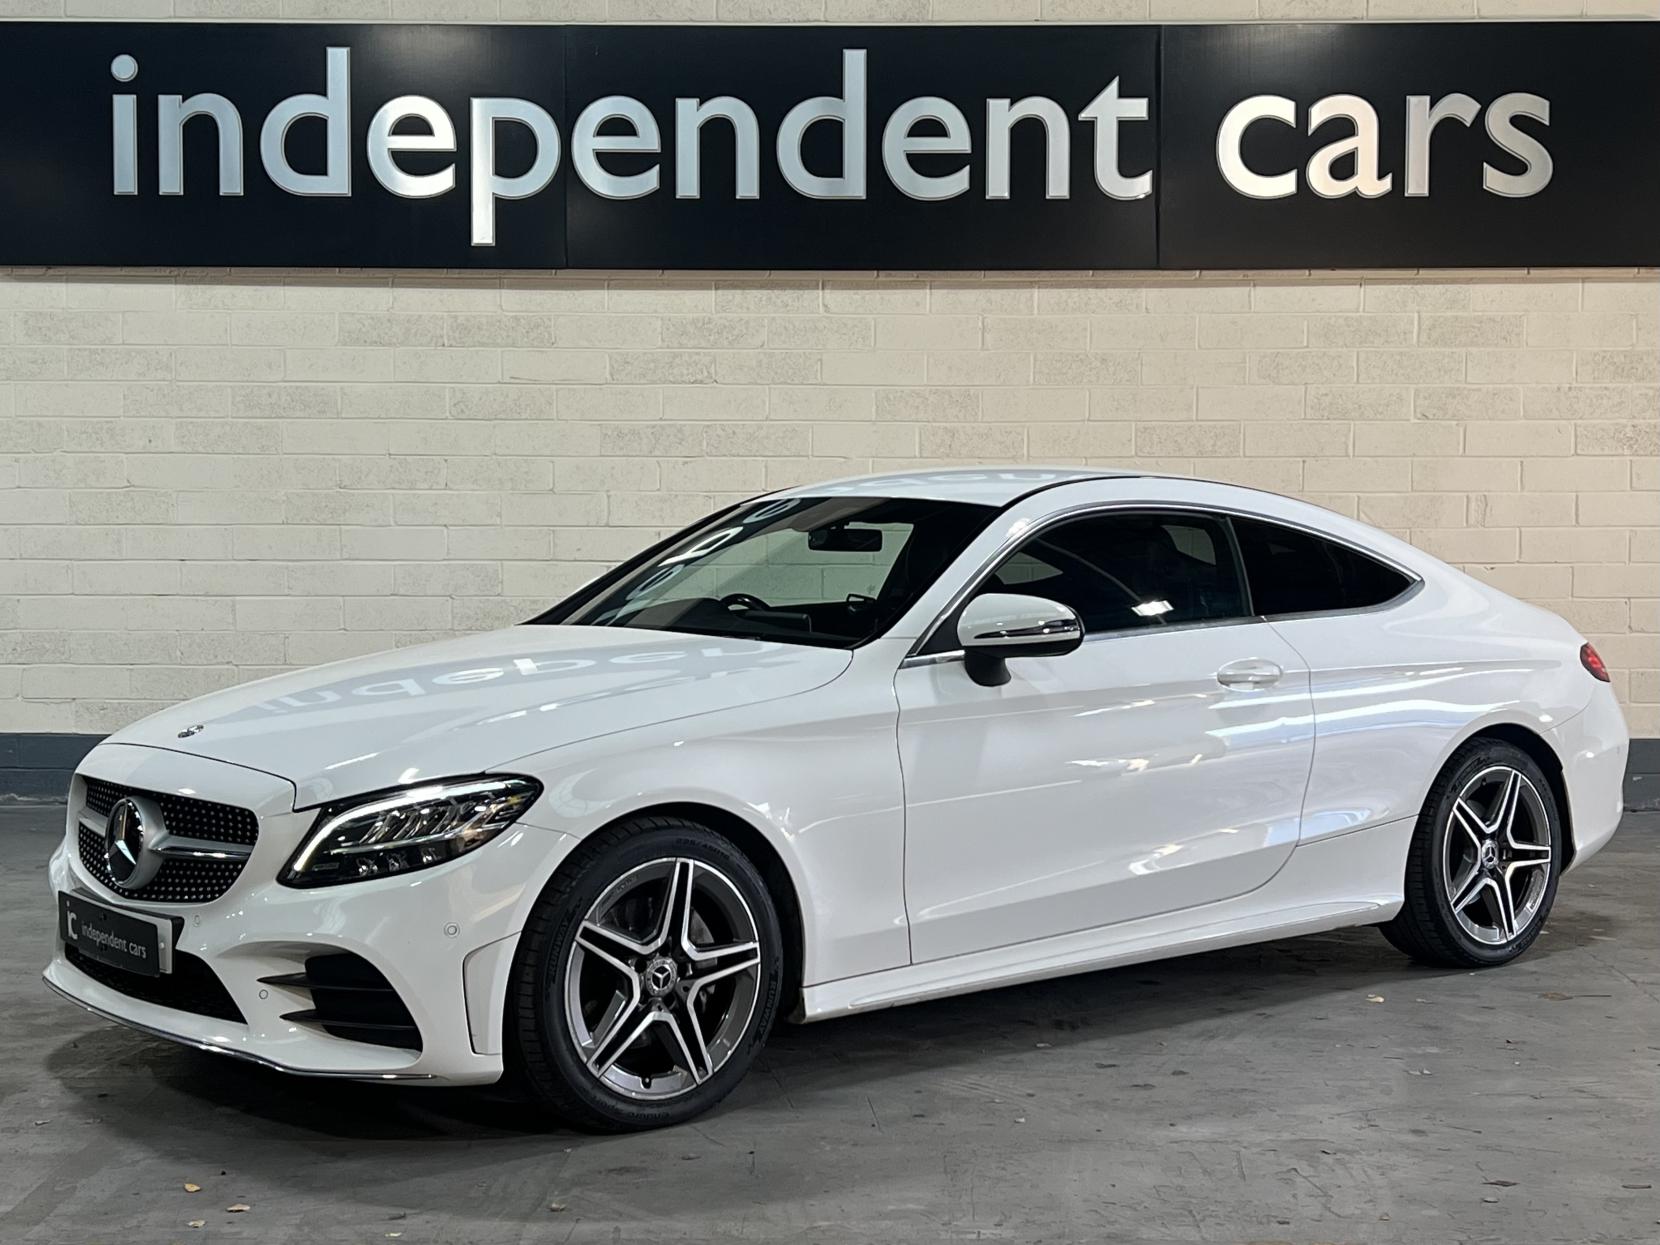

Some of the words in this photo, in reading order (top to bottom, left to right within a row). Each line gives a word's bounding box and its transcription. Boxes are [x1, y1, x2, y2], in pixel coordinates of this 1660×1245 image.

[110, 46, 1153, 247] independent
[1215, 91, 1555, 199] cars
[81, 920, 128, 953] independent
[128, 941, 147, 959] cars
